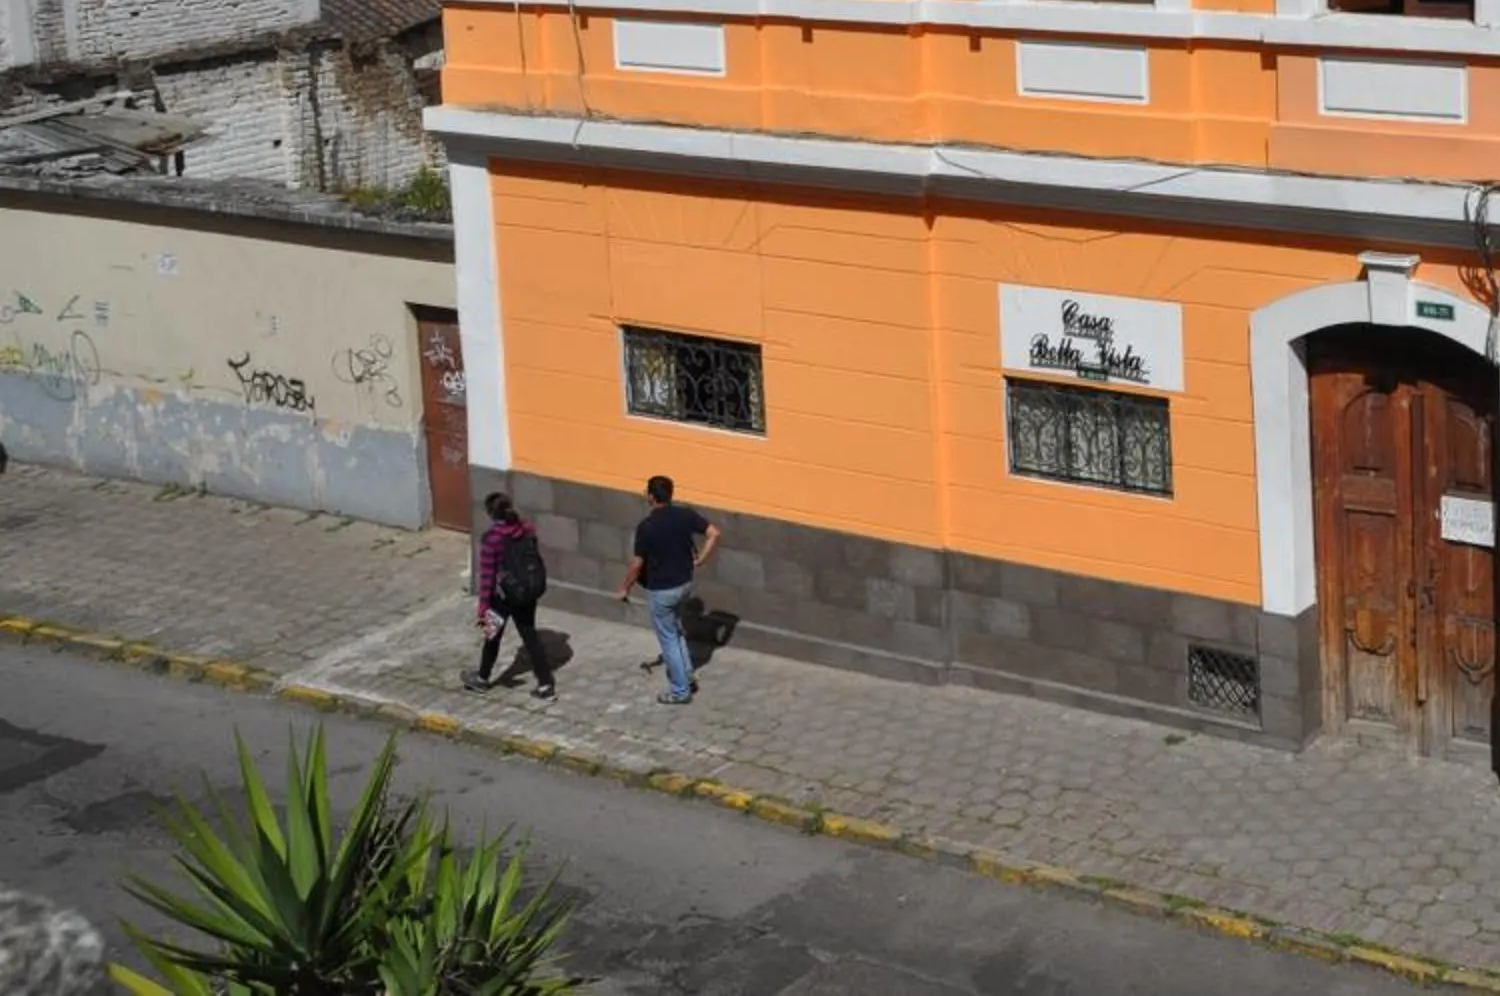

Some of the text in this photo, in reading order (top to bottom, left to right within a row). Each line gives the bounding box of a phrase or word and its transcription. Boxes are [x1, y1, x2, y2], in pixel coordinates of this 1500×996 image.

[1062, 299, 1114, 333] Casa
[1030, 333, 1144, 372] Bella Vista
